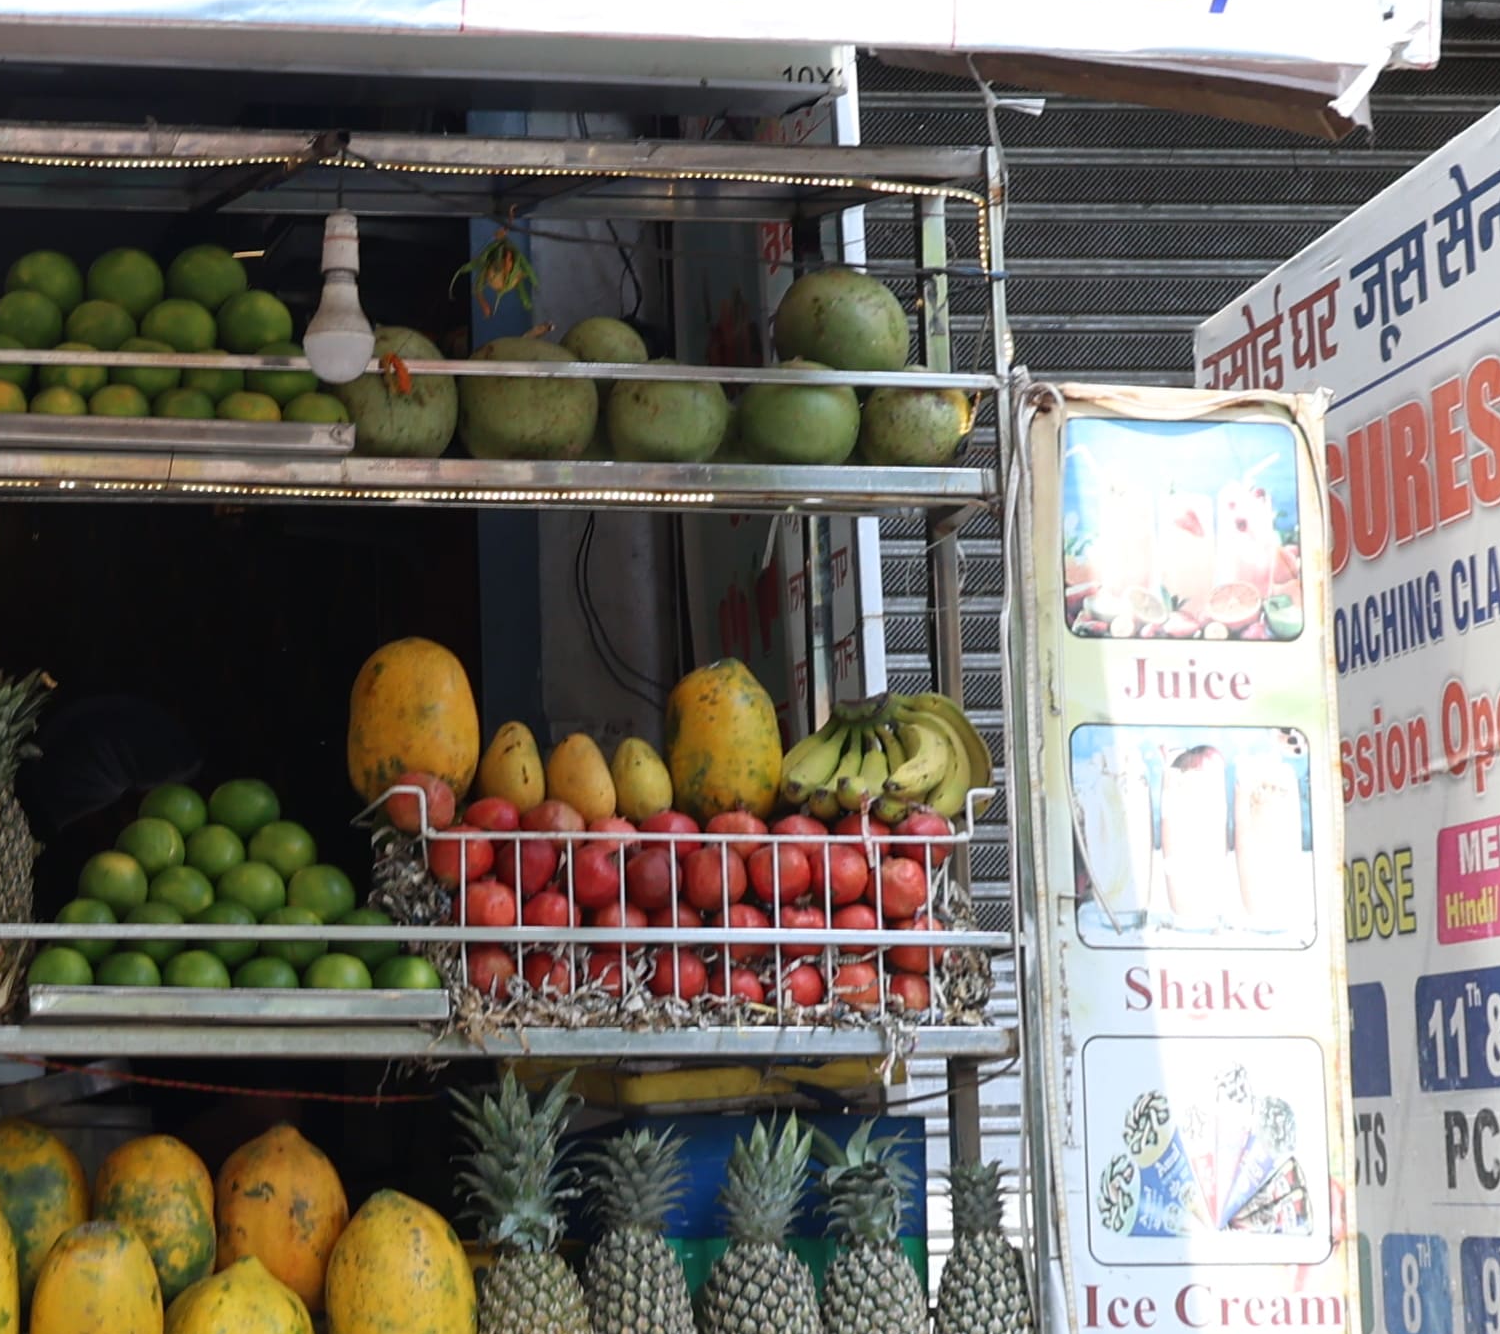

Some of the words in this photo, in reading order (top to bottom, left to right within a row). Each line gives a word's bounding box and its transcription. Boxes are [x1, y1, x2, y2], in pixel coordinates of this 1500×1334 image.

[1288, 276, 1341, 373] घर
[1349, 220, 1429, 364] जूस
[1333, 568, 1443, 676] OACHING
[1123, 657, 1254, 703] Juice
[1340, 706, 1431, 806] ssion
[1124, 966, 1277, 1014] Shake
[1081, 1282, 1159, 1330] Ice
[1173, 1279, 1345, 1332] Cream
